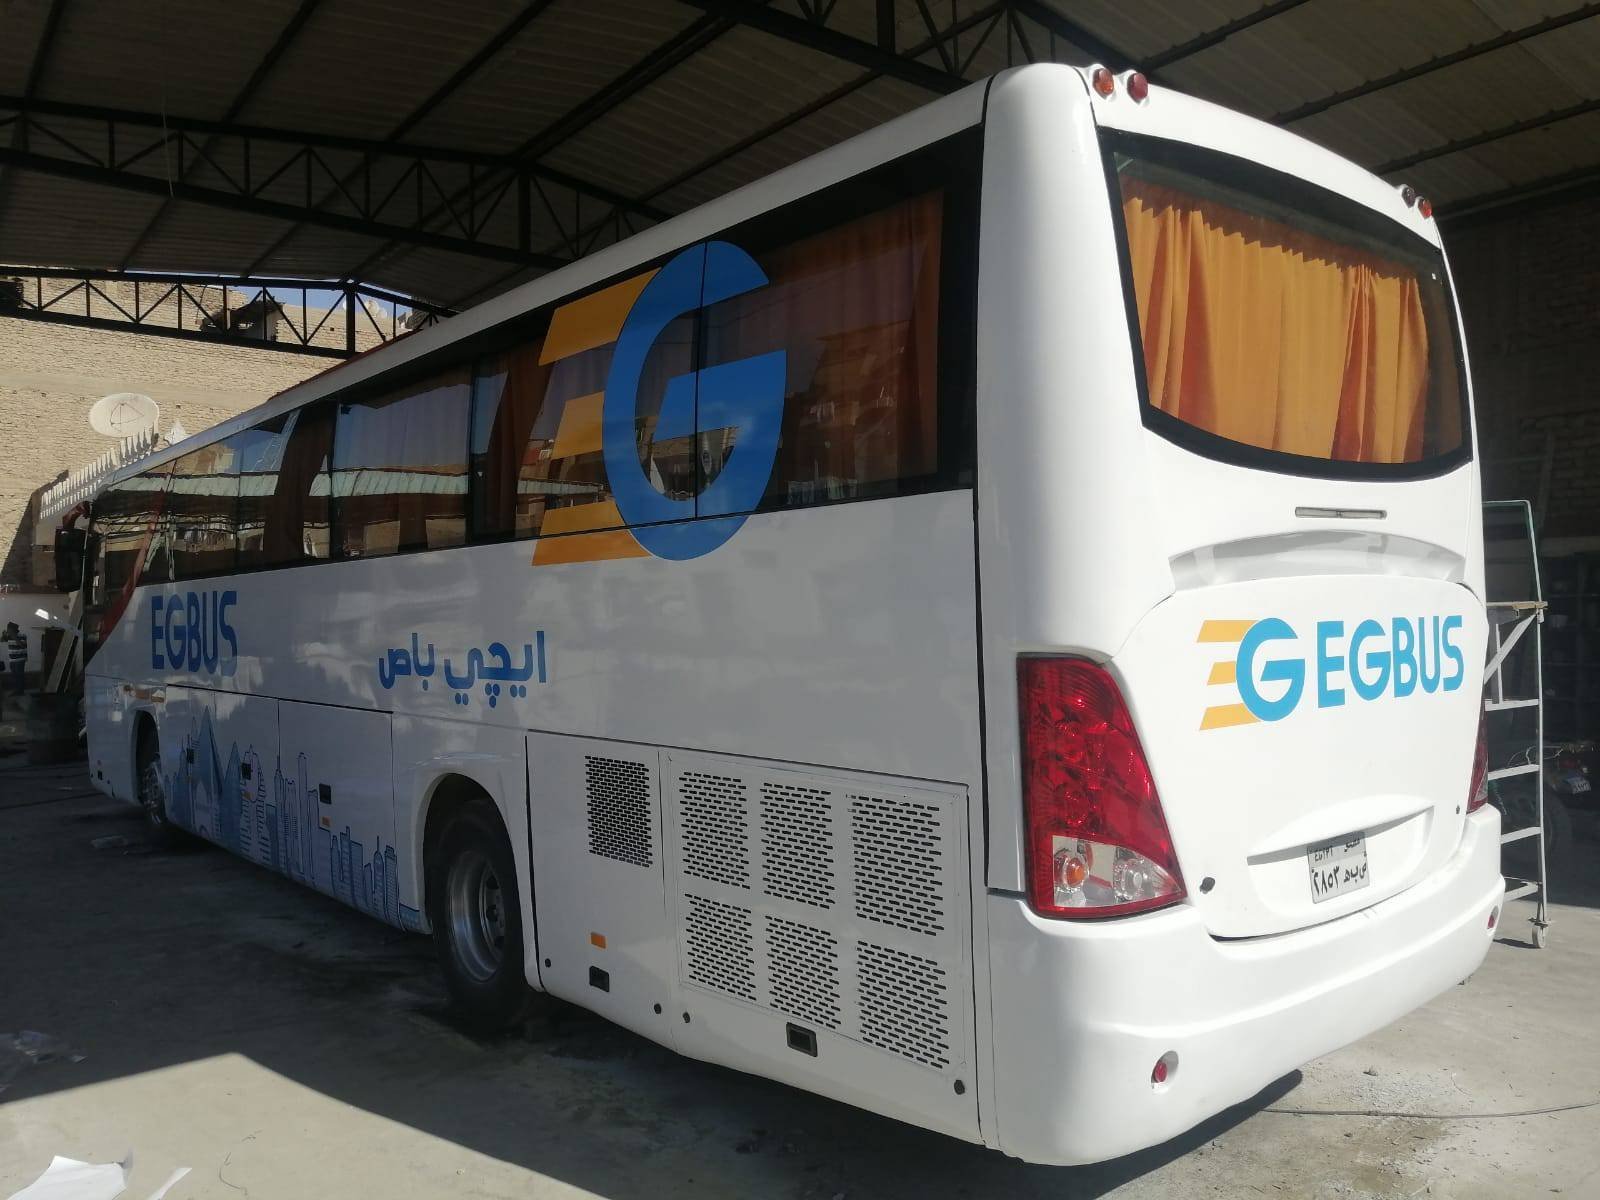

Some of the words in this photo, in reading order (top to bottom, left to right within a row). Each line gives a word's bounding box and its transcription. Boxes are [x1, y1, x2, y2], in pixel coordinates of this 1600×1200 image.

[151, 590, 238, 677] EGBUS
[378, 632, 436, 692] باص
[1316, 614, 1465, 709] EGBUS
